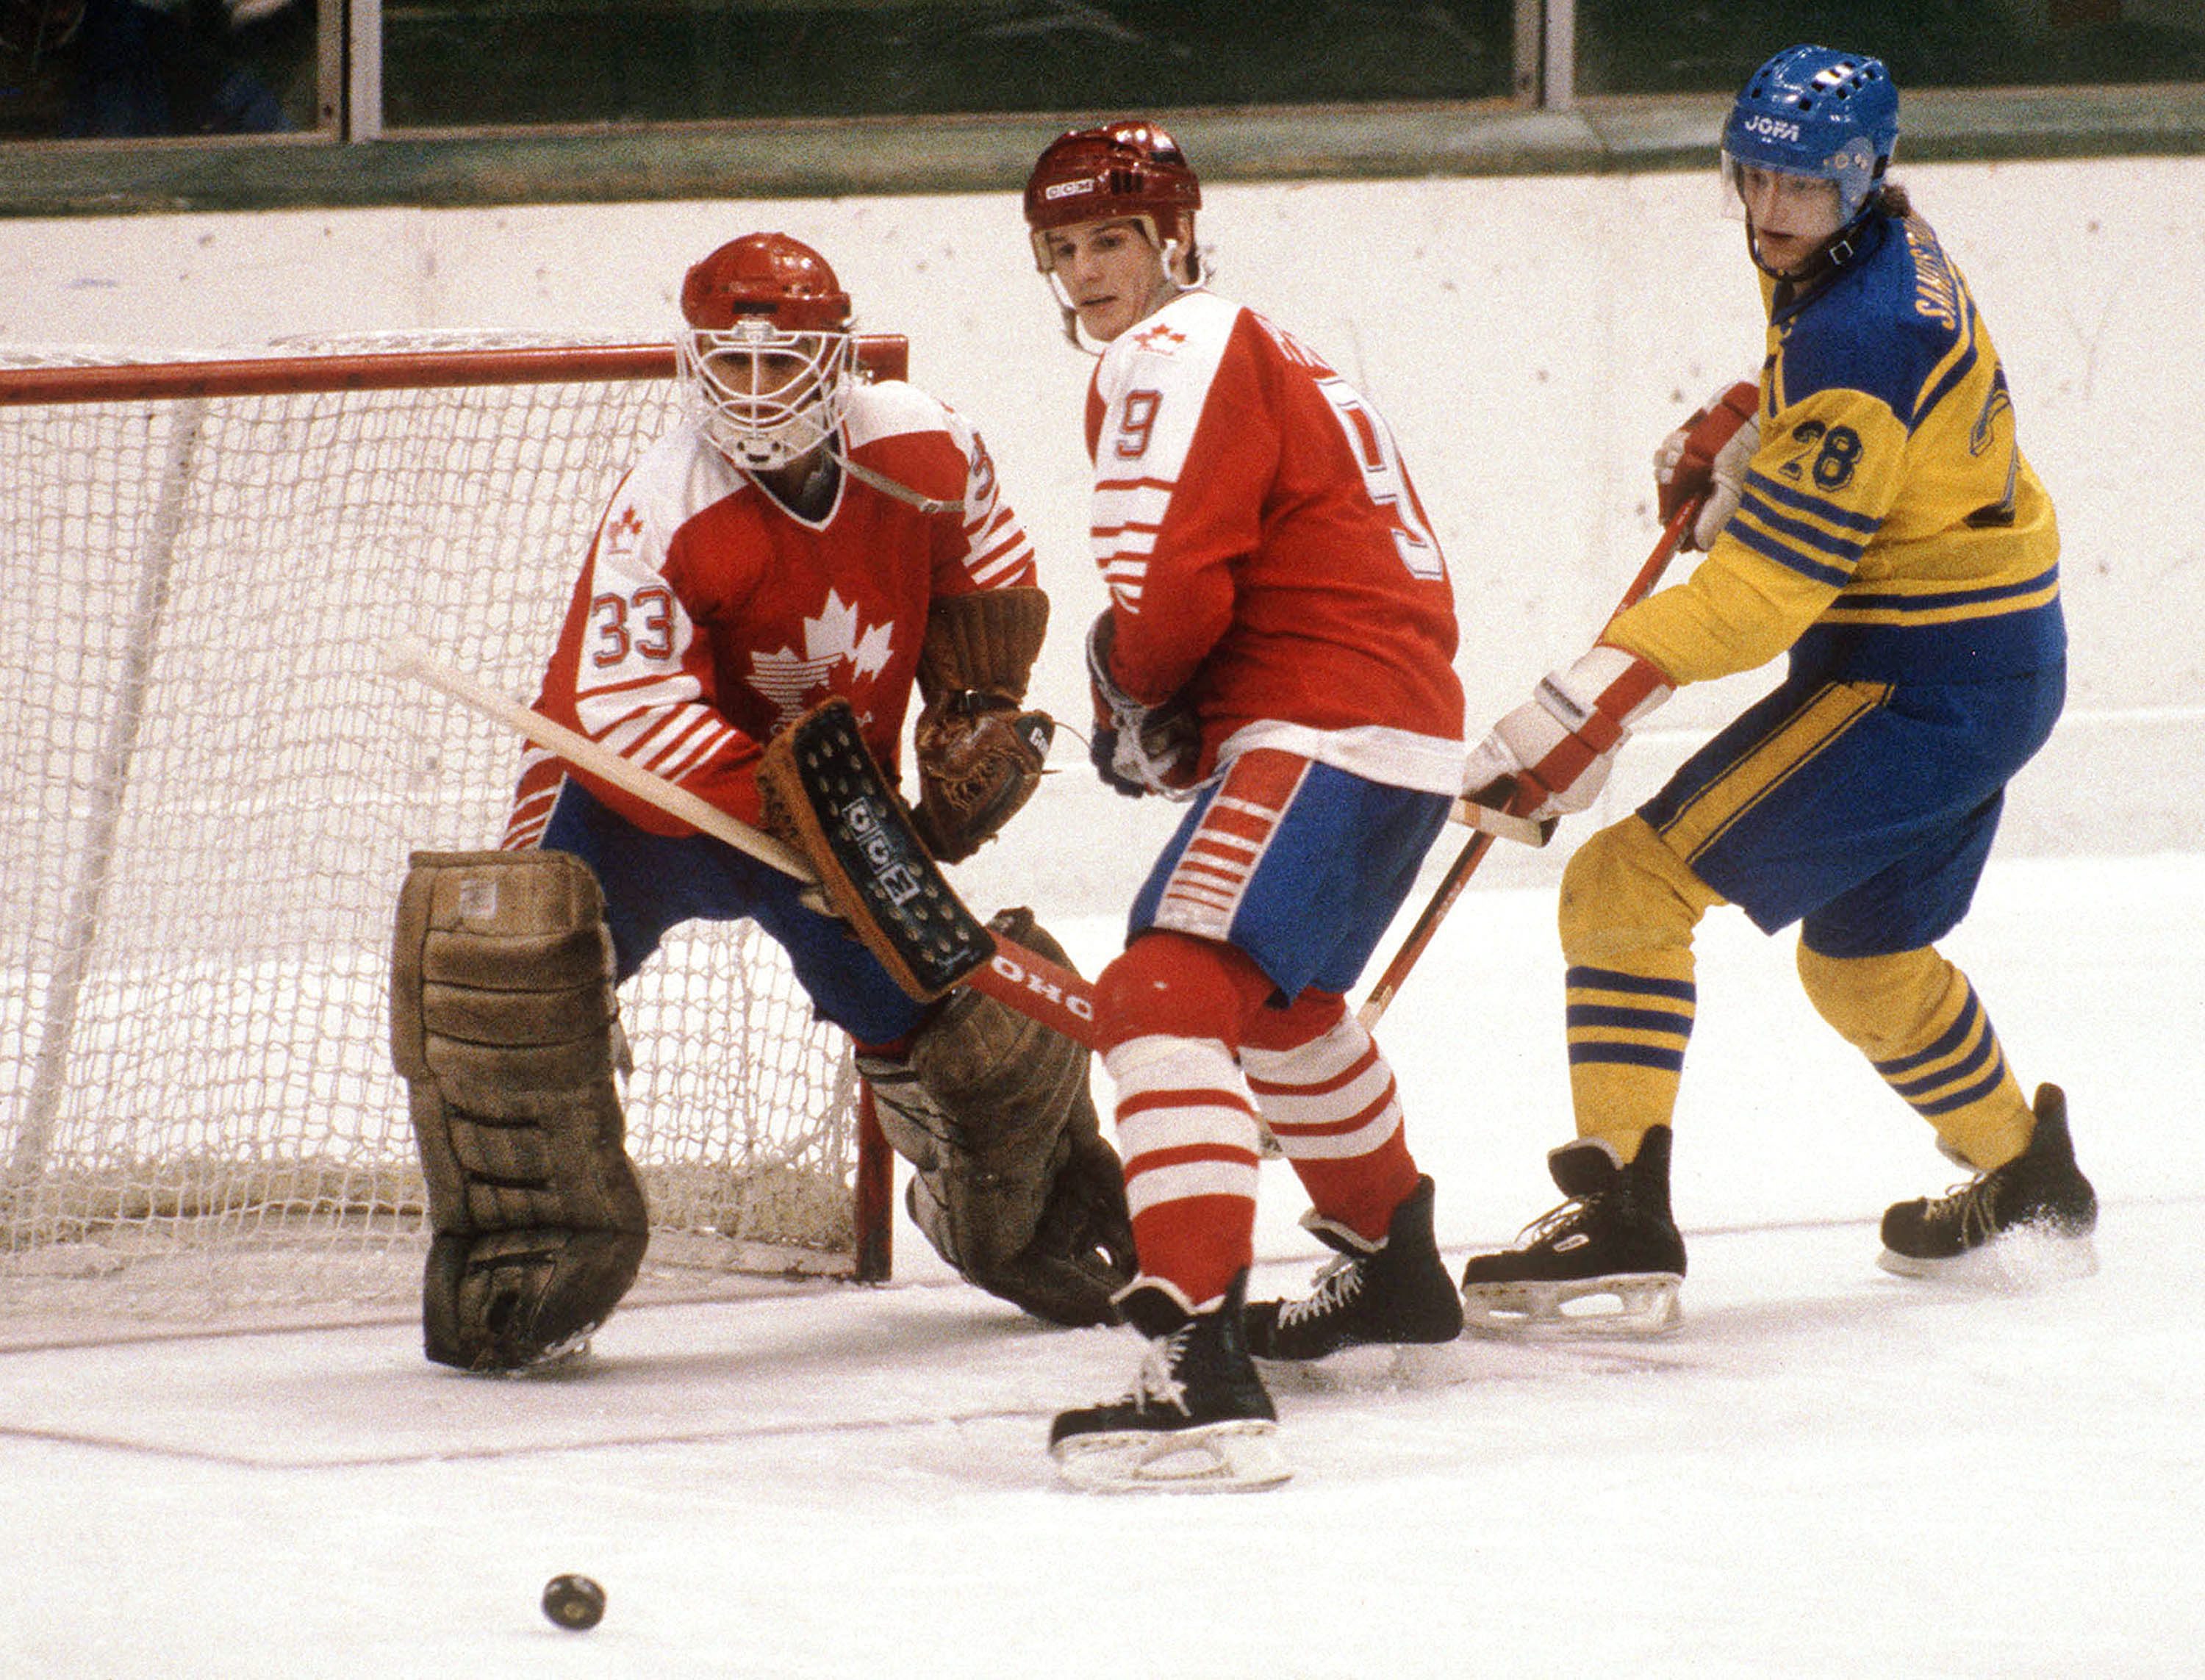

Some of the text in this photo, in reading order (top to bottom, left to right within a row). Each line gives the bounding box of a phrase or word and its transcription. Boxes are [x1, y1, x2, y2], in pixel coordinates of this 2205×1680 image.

[1744, 115, 1799, 142] JOFA
[1046, 179, 1094, 200] CCM
[1114, 390, 1164, 460] 9
[1778, 420, 1863, 492] 28
[971, 430, 995, 502] 3
[1312, 371, 1443, 580] 9
[592, 585, 677, 669] 33
[842, 797, 920, 907] CCM
[992, 955, 1094, 1022] OHO
